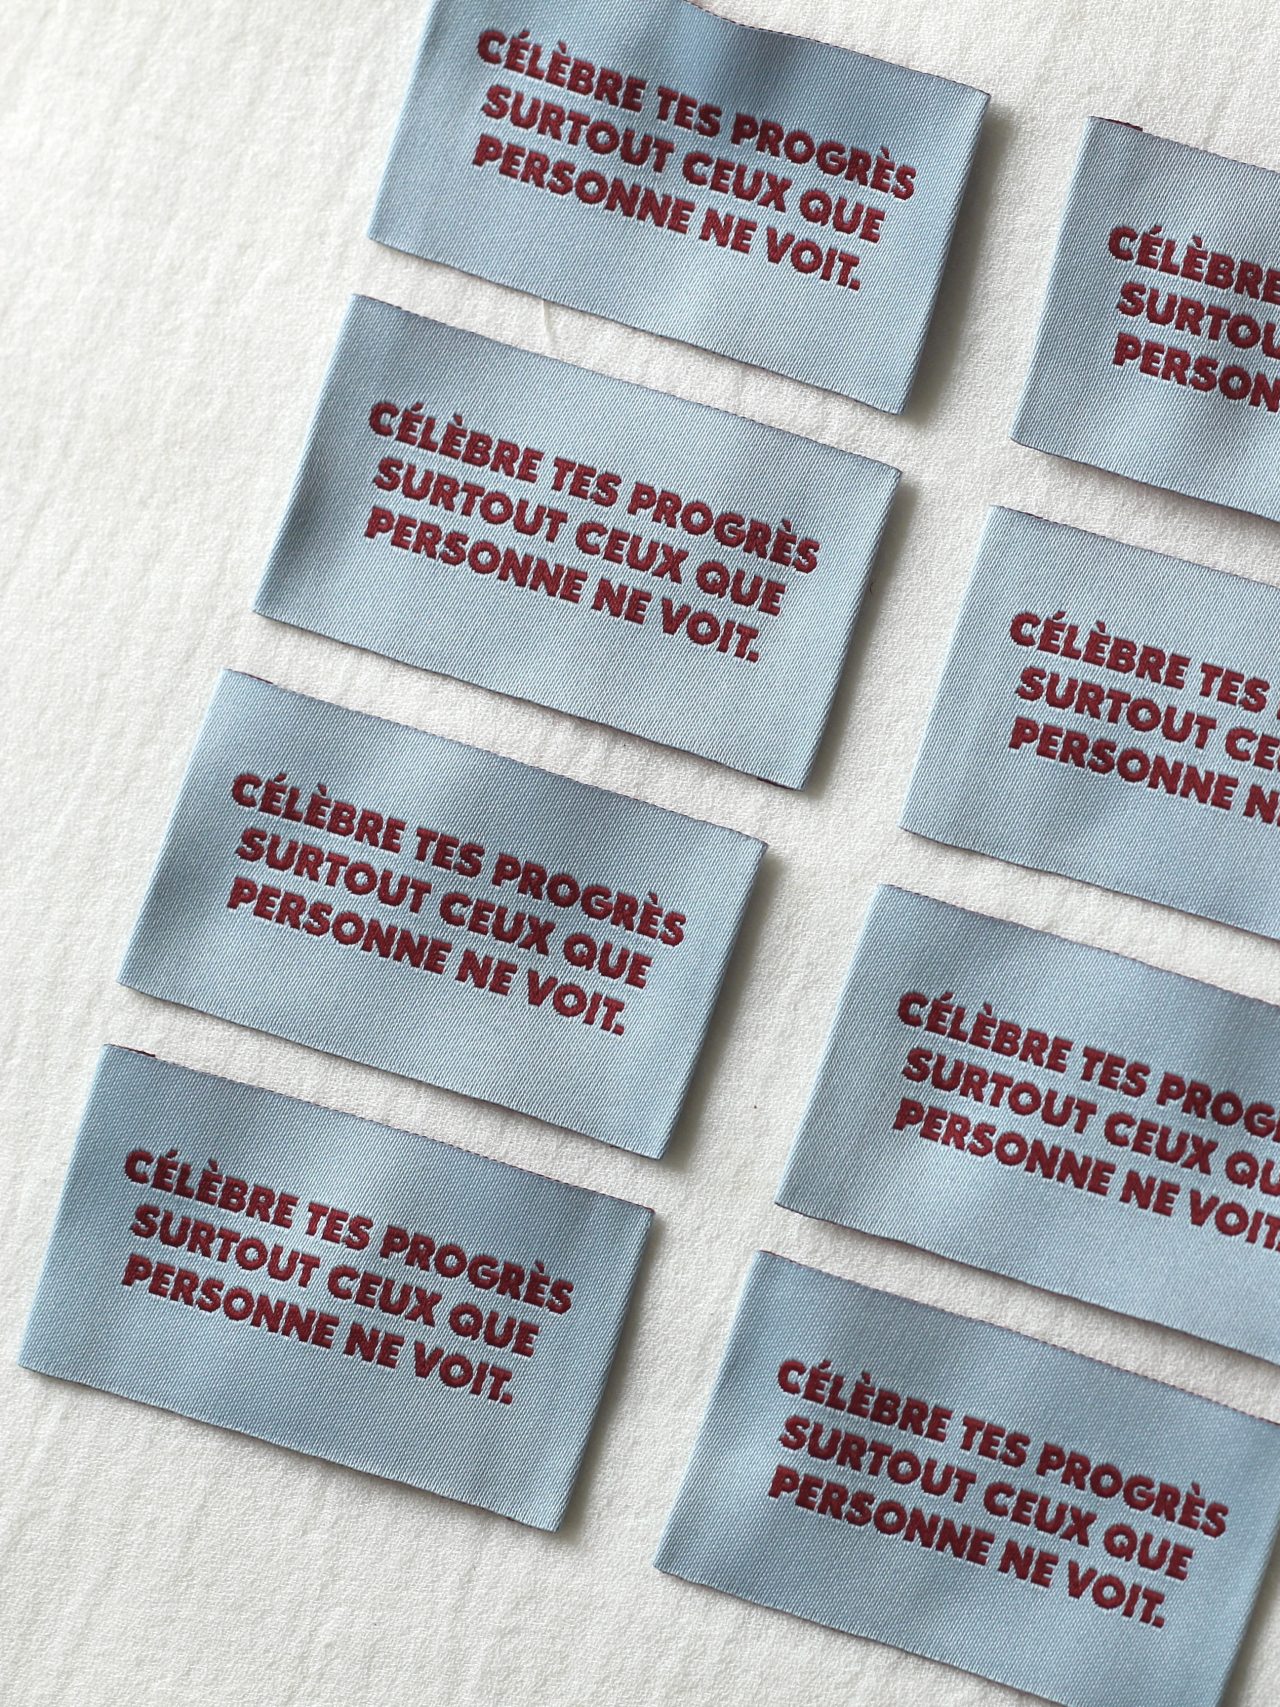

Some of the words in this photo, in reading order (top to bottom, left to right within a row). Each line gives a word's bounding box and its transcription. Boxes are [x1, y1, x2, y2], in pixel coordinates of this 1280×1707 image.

[477, 30, 644, 110] CÉLÈBRE
[656, 87, 718, 135] TES
[730, 114, 914, 199] PROGRÈS
[481, 85, 673, 170] SURTOUT
[681, 152, 789, 211] CEUX
[798, 189, 883, 242] QUE
[472, 134, 694, 232] PERSONNE
[699, 209, 755, 252] NE
[765, 227, 858, 289] VOIT.
[368, 402, 542, 481] CÉLÈBRE
[552, 457, 619, 505] TES
[626, 482, 818, 572] PROGRÈS
[373, 457, 566, 541] SURTOUT
[574, 521, 686, 582] CEUX
[694, 560, 783, 614] QUE
[365, 506, 586, 602] PERSONNE
[591, 578, 650, 623] NE
[660, 598, 757, 661] VOIT.
[1008, 611, 1188, 687] CÉLÈBRE
[1198, 663, 1268, 711] TES
[1008, 716, 1237, 808] PERSONNE
[1016, 667, 1215, 747] SURTOUT
[231, 773, 404, 852] CÉLÈBRE
[414, 827, 482, 876] TES
[491, 853, 684, 945] PROGRÈS
[236, 827, 430, 911] SURTOUT
[438, 892, 553, 954] CEUX
[562, 933, 650, 987] QUE
[227, 877, 450, 972] PERSONNE
[455, 950, 516, 994] NE
[526, 970, 622, 1034] VOIT.
[897, 992, 1070, 1071] CÉLÈBRE
[1081, 1047, 1148, 1095] TES
[902, 1048, 1095, 1131] SURTOUT
[1103, 1112, 1214, 1172] CEUX
[124, 1150, 296, 1227] CÉLÈBRE
[306, 1202, 371, 1248] TES
[379, 1226, 571, 1312] PROGRÈS
[893, 1098, 1114, 1194] PERSONNE
[1119, 1171, 1178, 1215] NE
[121, 1253, 338, 1347] PERSONNE
[343, 1323, 403, 1366] NE
[414, 1342, 510, 1403] VOIT.
[131, 1205, 318, 1286] SURTOUT
[326, 1265, 440, 1324] CEUX
[447, 1303, 537, 1355] QUE
[777, 1360, 950, 1440] CÉLÈBRE
[960, 1416, 1028, 1465] TES
[1035, 1443, 1226, 1536] PROGRÈS
[778, 1415, 974, 1500] SURTOUT
[982, 1482, 1094, 1544] CEUX
[1102, 1523, 1191, 1578] QUE
[767, 1465, 993, 1563] PERSONNE
[998, 1540, 1056, 1585] NE
[1067, 1561, 1162, 1626] VOIT.
